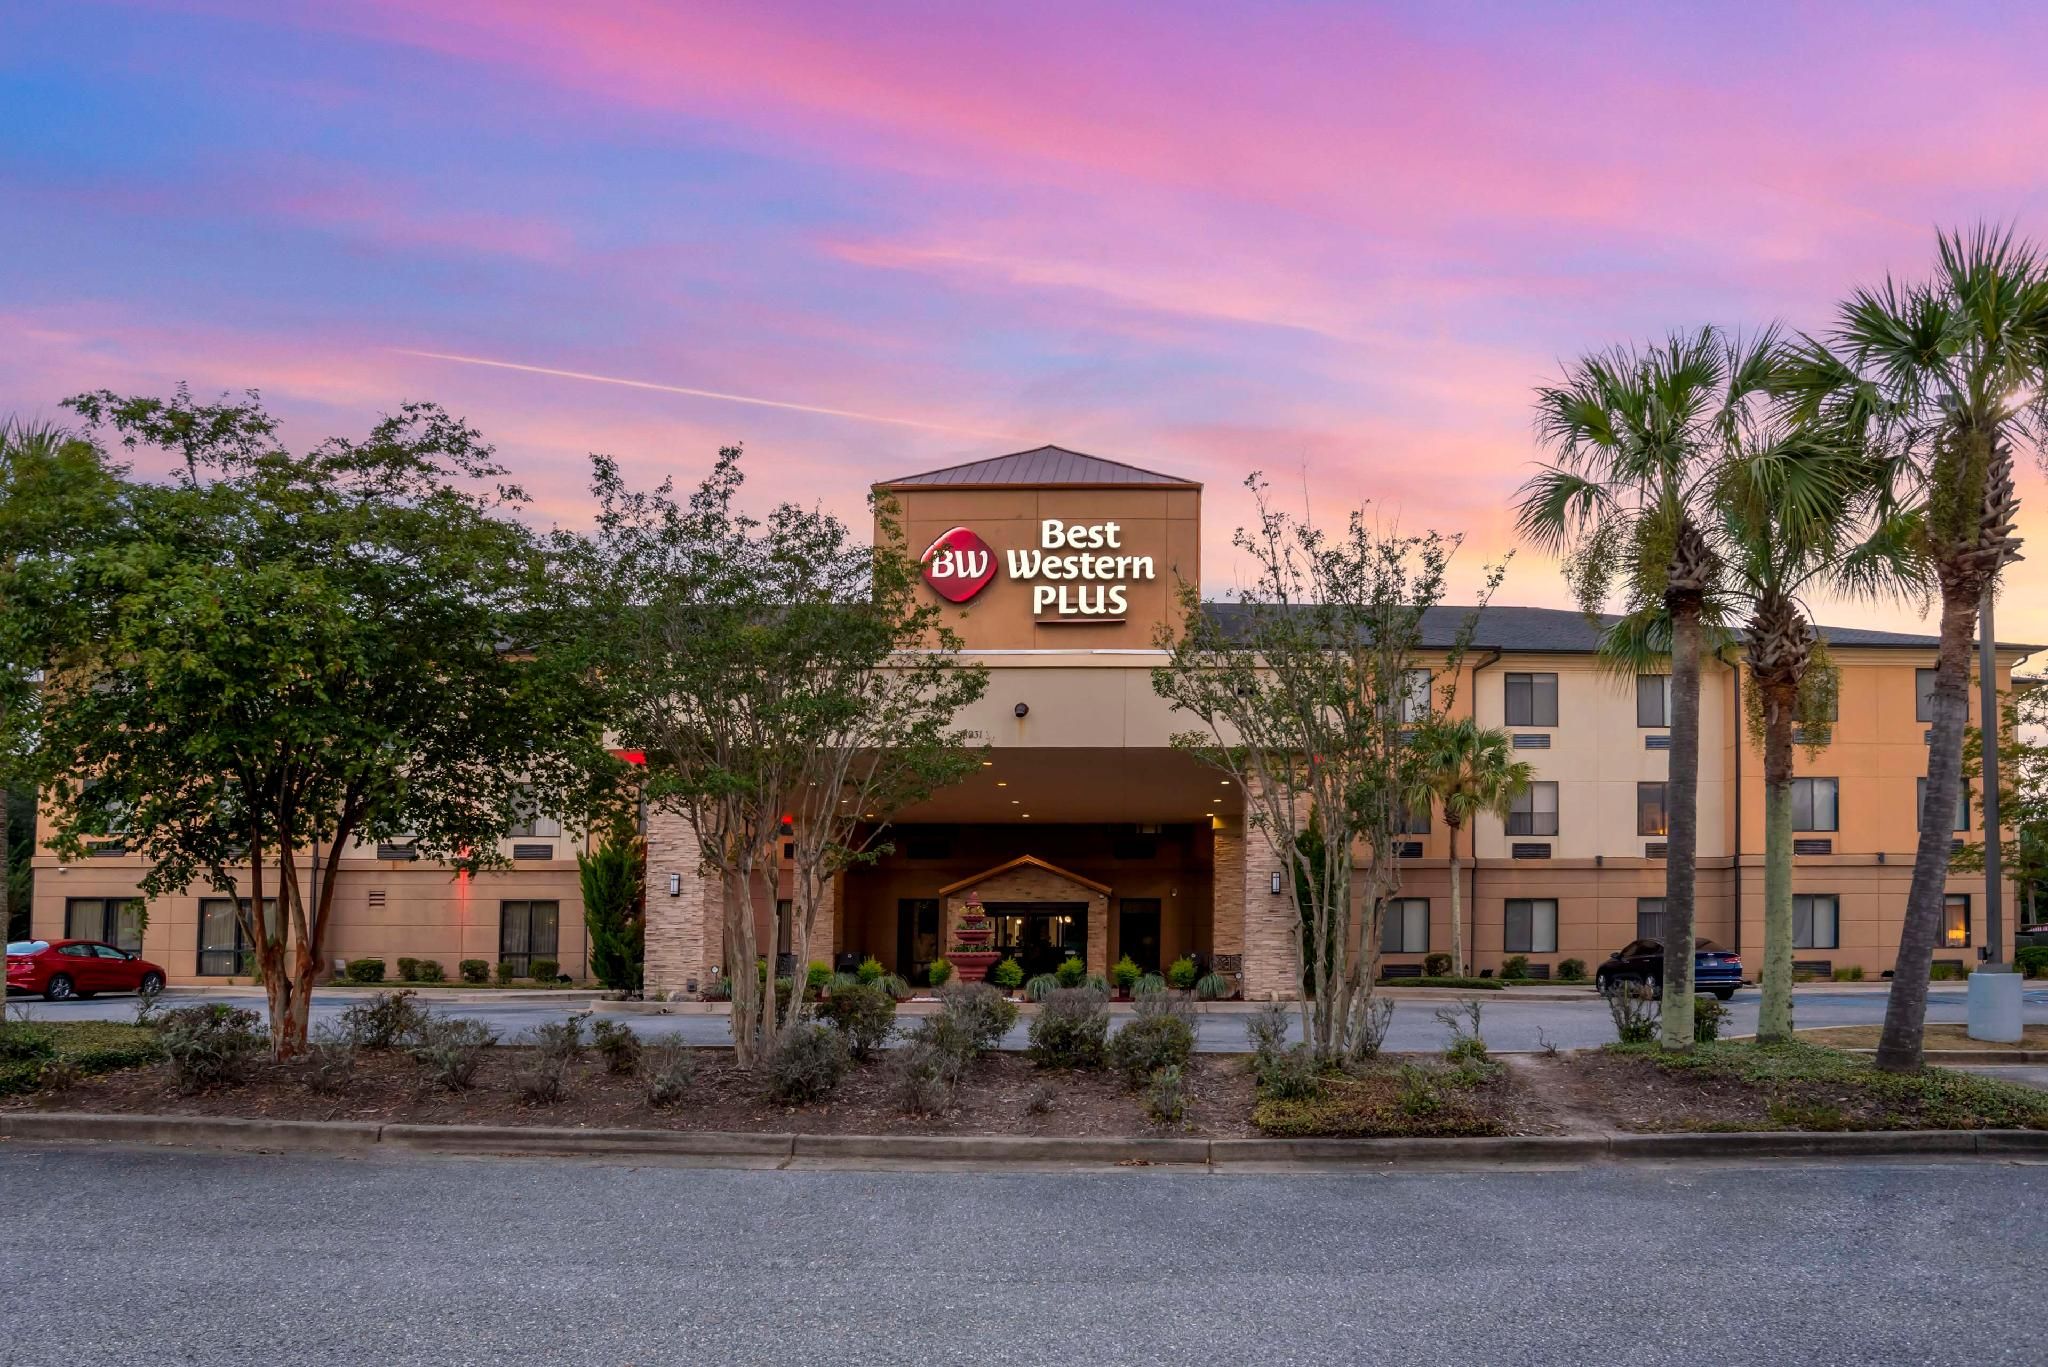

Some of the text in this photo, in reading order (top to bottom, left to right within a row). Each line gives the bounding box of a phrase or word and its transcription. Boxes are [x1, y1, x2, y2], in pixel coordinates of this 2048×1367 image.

[1041, 519, 1121, 549] Best
[931, 550, 988, 578] BW
[1007, 549, 1156, 580] Western
[1033, 585, 1128, 615] PLUS
